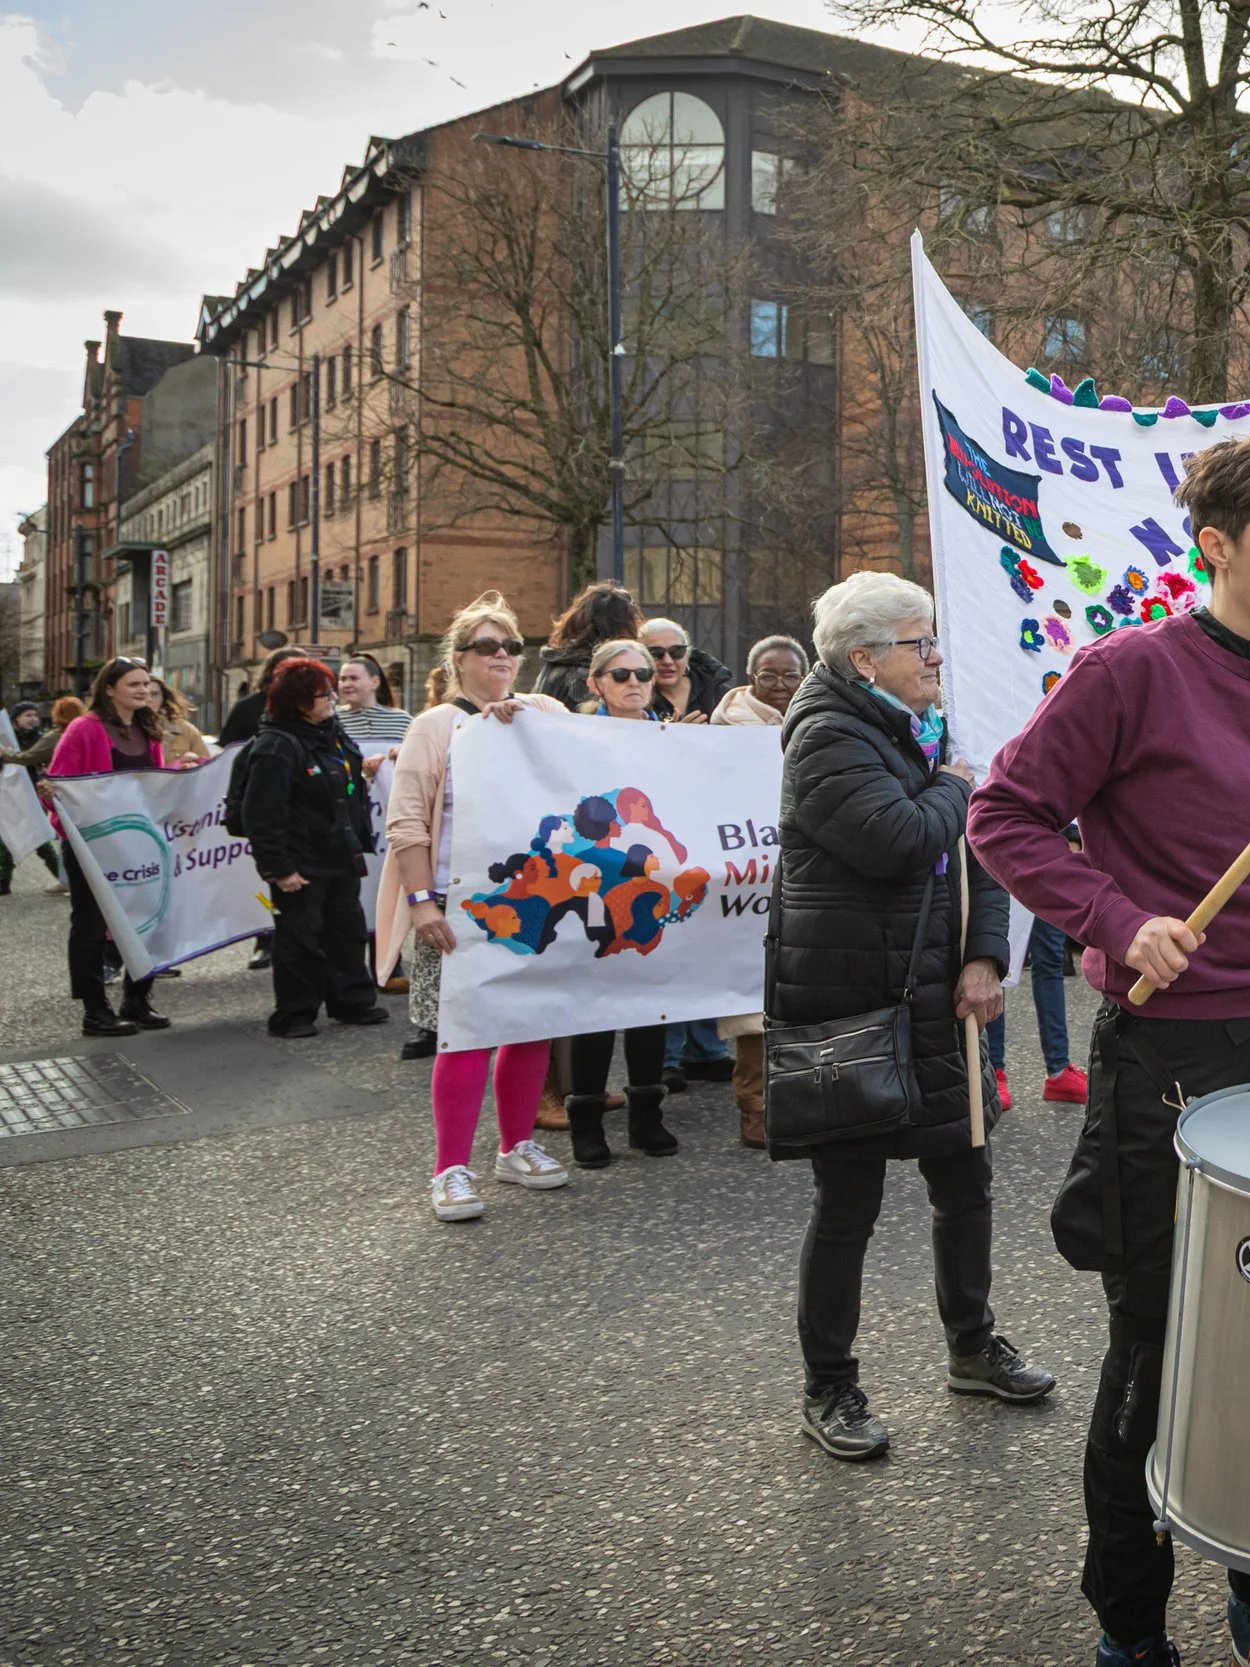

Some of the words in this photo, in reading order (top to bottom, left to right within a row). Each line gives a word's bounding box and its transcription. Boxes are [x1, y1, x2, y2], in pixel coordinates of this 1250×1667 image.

[963, 440, 991, 477] THE
[1002, 406, 1124, 489] REST
[957, 461, 990, 505] WILL
[989, 494, 1022, 529] NOT
[966, 488, 1032, 550] KNITTED
[155, 552, 166, 625] ARCADE
[717, 819, 779, 851] Bla
[103, 872, 119, 882] e
[720, 892, 771, 918] Wo
